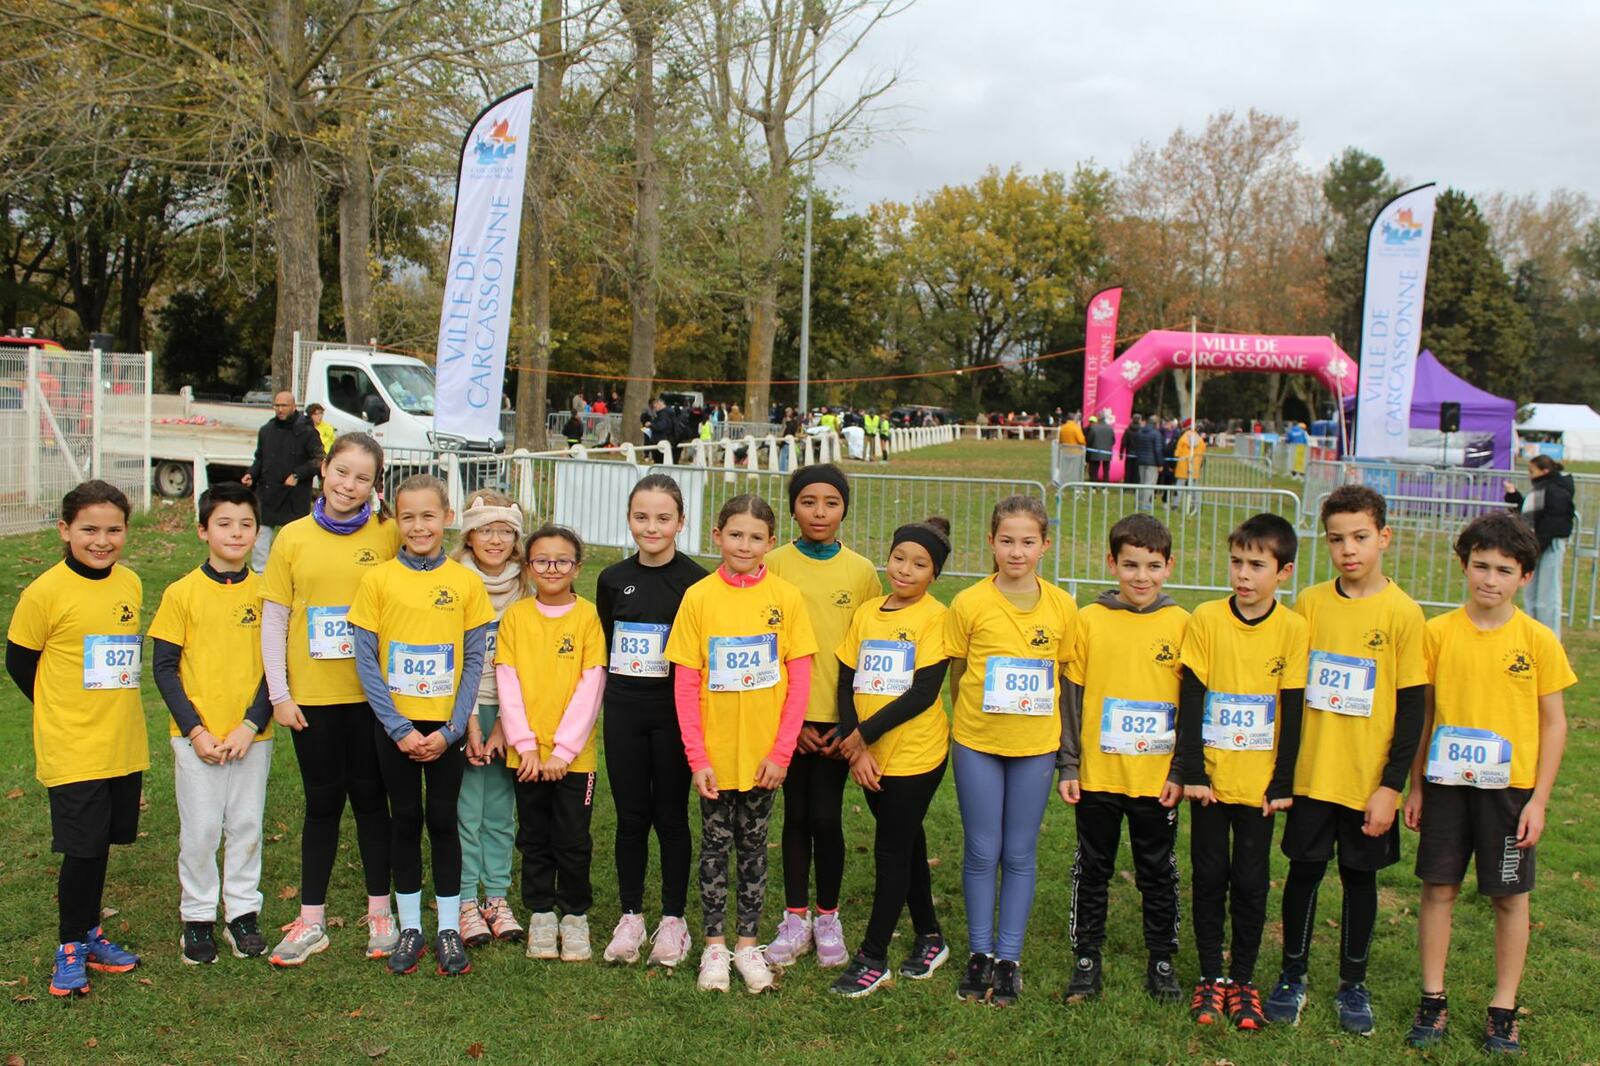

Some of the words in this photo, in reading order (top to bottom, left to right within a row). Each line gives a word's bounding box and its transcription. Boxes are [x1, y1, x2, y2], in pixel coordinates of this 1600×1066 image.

[456, 245, 478, 286] DE
[466, 195, 511, 409] CARCASSONNE
[444, 290, 473, 364] VILLE
[1371, 308, 1390, 336] DE
[1202, 336, 1248, 353] VILLE
[1255, 338, 1279, 354] DE
[1385, 269, 1418, 437] CARCASSONNE
[1087, 354, 1098, 371] DE
[1172, 350, 1308, 370] CARCASSONNE
[1364, 342, 1387, 403] VILLE
[1086, 375, 1098, 405] VILLE
[620, 636, 650, 655] 833
[105, 649, 134, 666] 827
[403, 658, 436, 676] 842
[726, 650, 760, 669] 824
[863, 654, 893, 672] 820
[1005, 673, 1039, 692] 830
[1319, 667, 1351, 690] 821
[1121, 715, 1157, 734] 832
[1219, 708, 1255, 728] 843
[1447, 742, 1487, 764] 840
